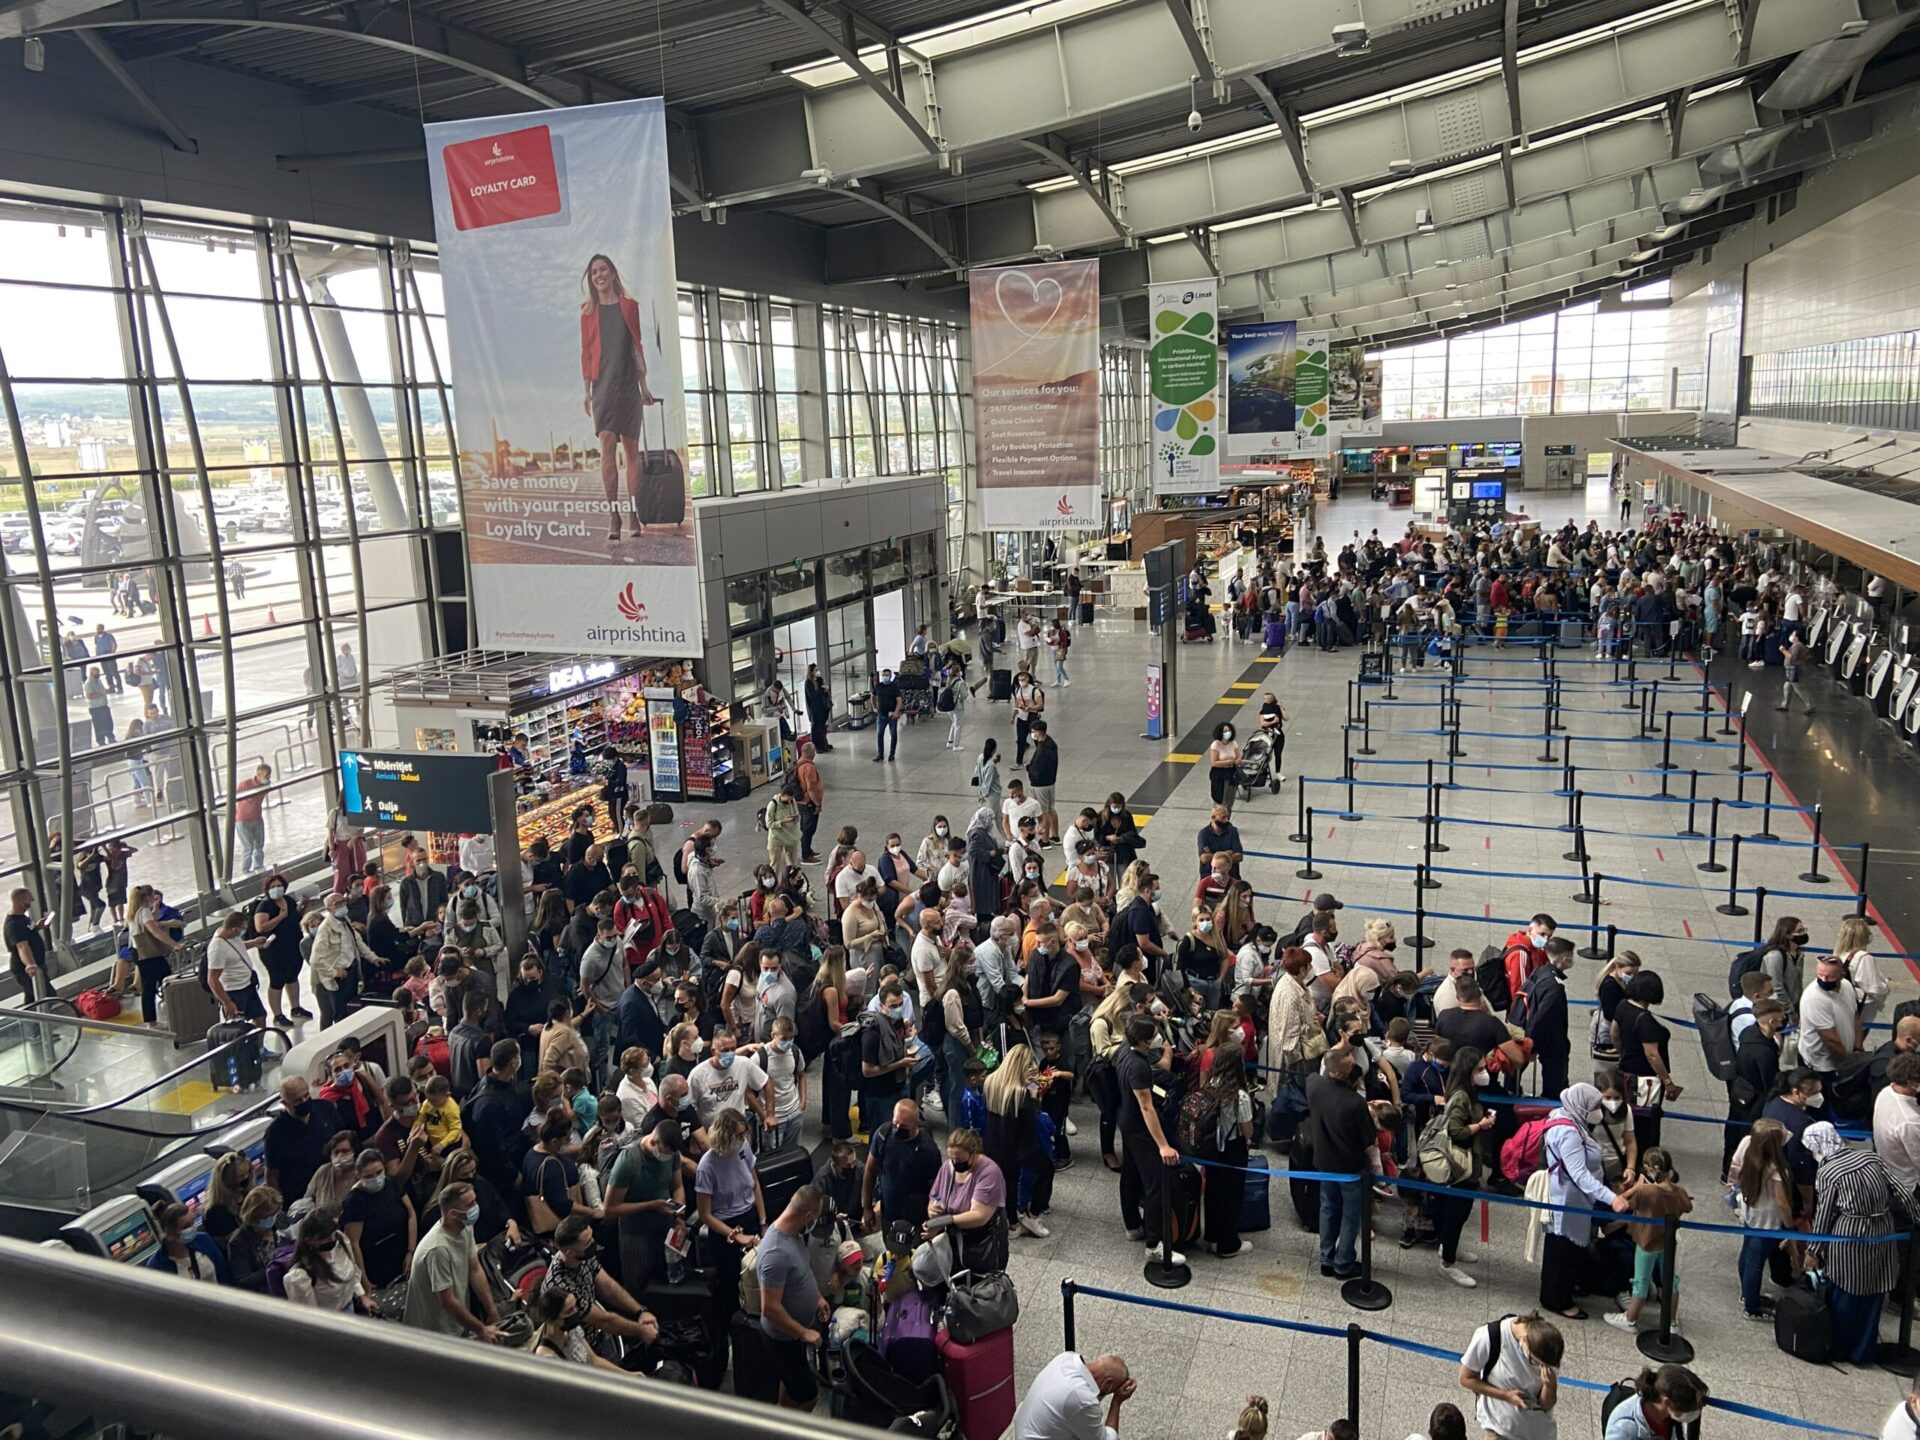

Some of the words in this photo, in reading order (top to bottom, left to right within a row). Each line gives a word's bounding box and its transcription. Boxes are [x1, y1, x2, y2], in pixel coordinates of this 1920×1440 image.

[470, 181, 508, 197] LOYALTY
[510, 176, 536, 188] CARD
[983, 388, 1000, 397] Our
[1001, 387, 1039, 396] services
[1041, 385, 1055, 394] for
[1057, 385, 1078, 396] you:
[481, 475, 519, 489] Save
[524, 478, 578, 492] money
[483, 497, 518, 512] with
[523, 502, 559, 516] your
[564, 496, 636, 517] personal
[486, 520, 543, 540] Loyalty
[548, 520, 590, 537] Card.
[1040, 517, 1094, 527] airprishtina
[587, 626, 686, 645] airprishtina
[586, 662, 615, 680] shop
[374, 760, 413, 773] Mbërritjet
[379, 801, 398, 813] Dalja
